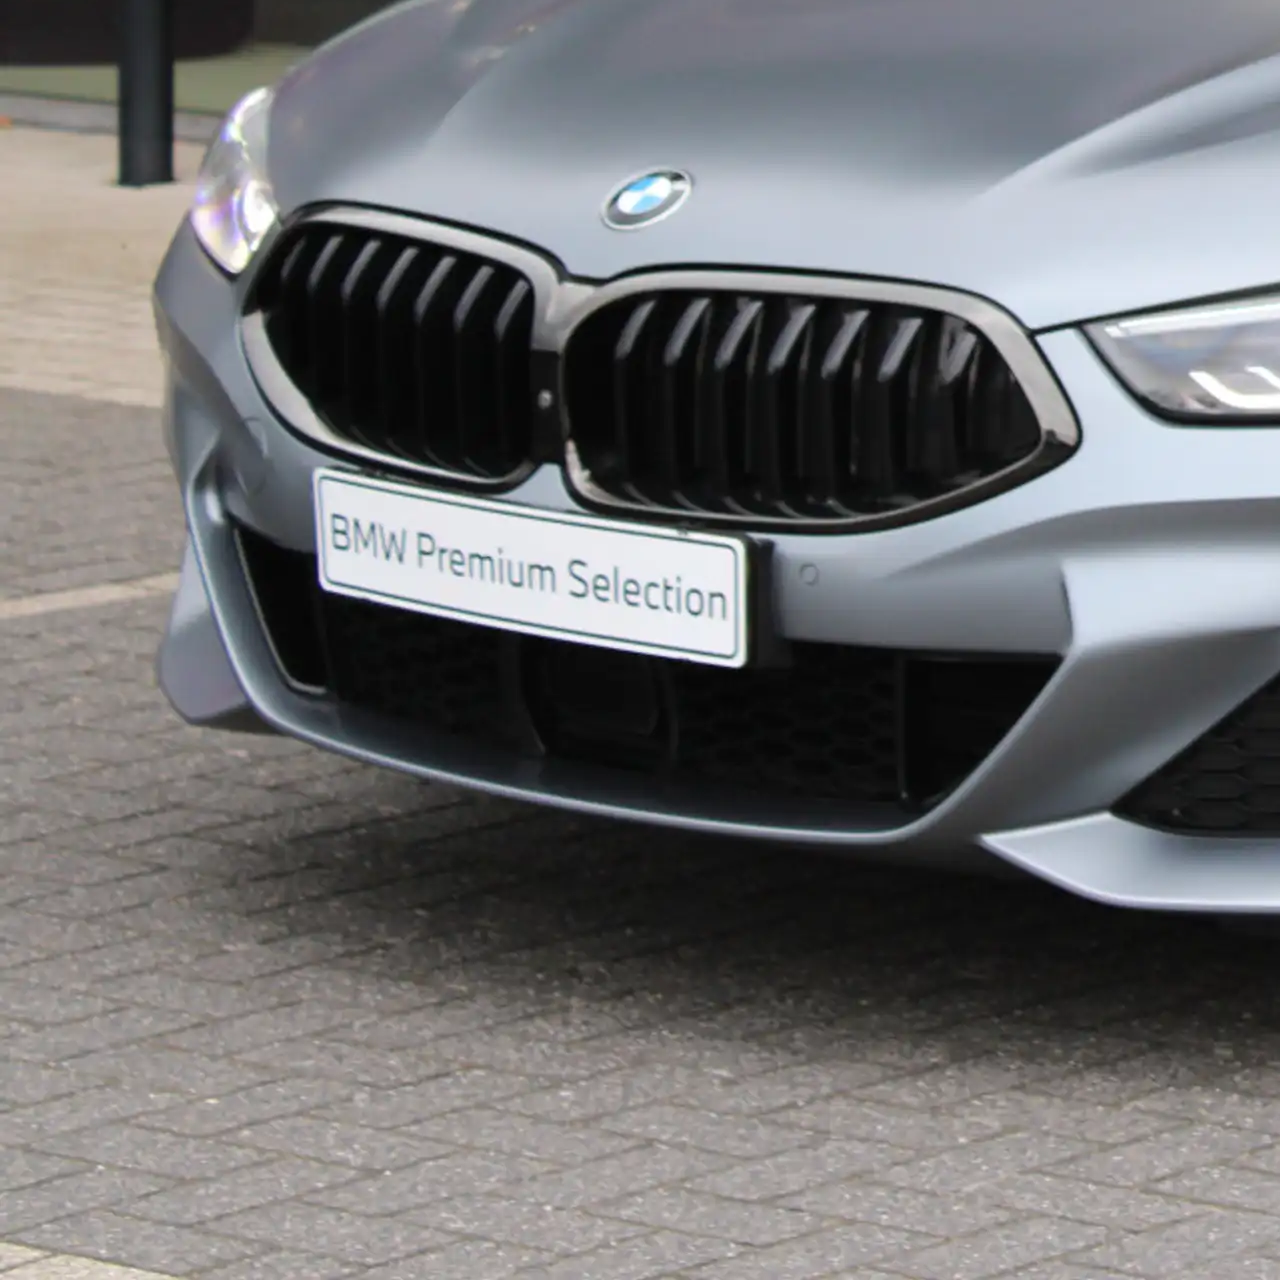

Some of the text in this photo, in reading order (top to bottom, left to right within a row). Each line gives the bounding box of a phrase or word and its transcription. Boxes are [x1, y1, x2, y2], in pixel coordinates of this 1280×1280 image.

[330, 512, 728, 620] BMW Premium Selection
